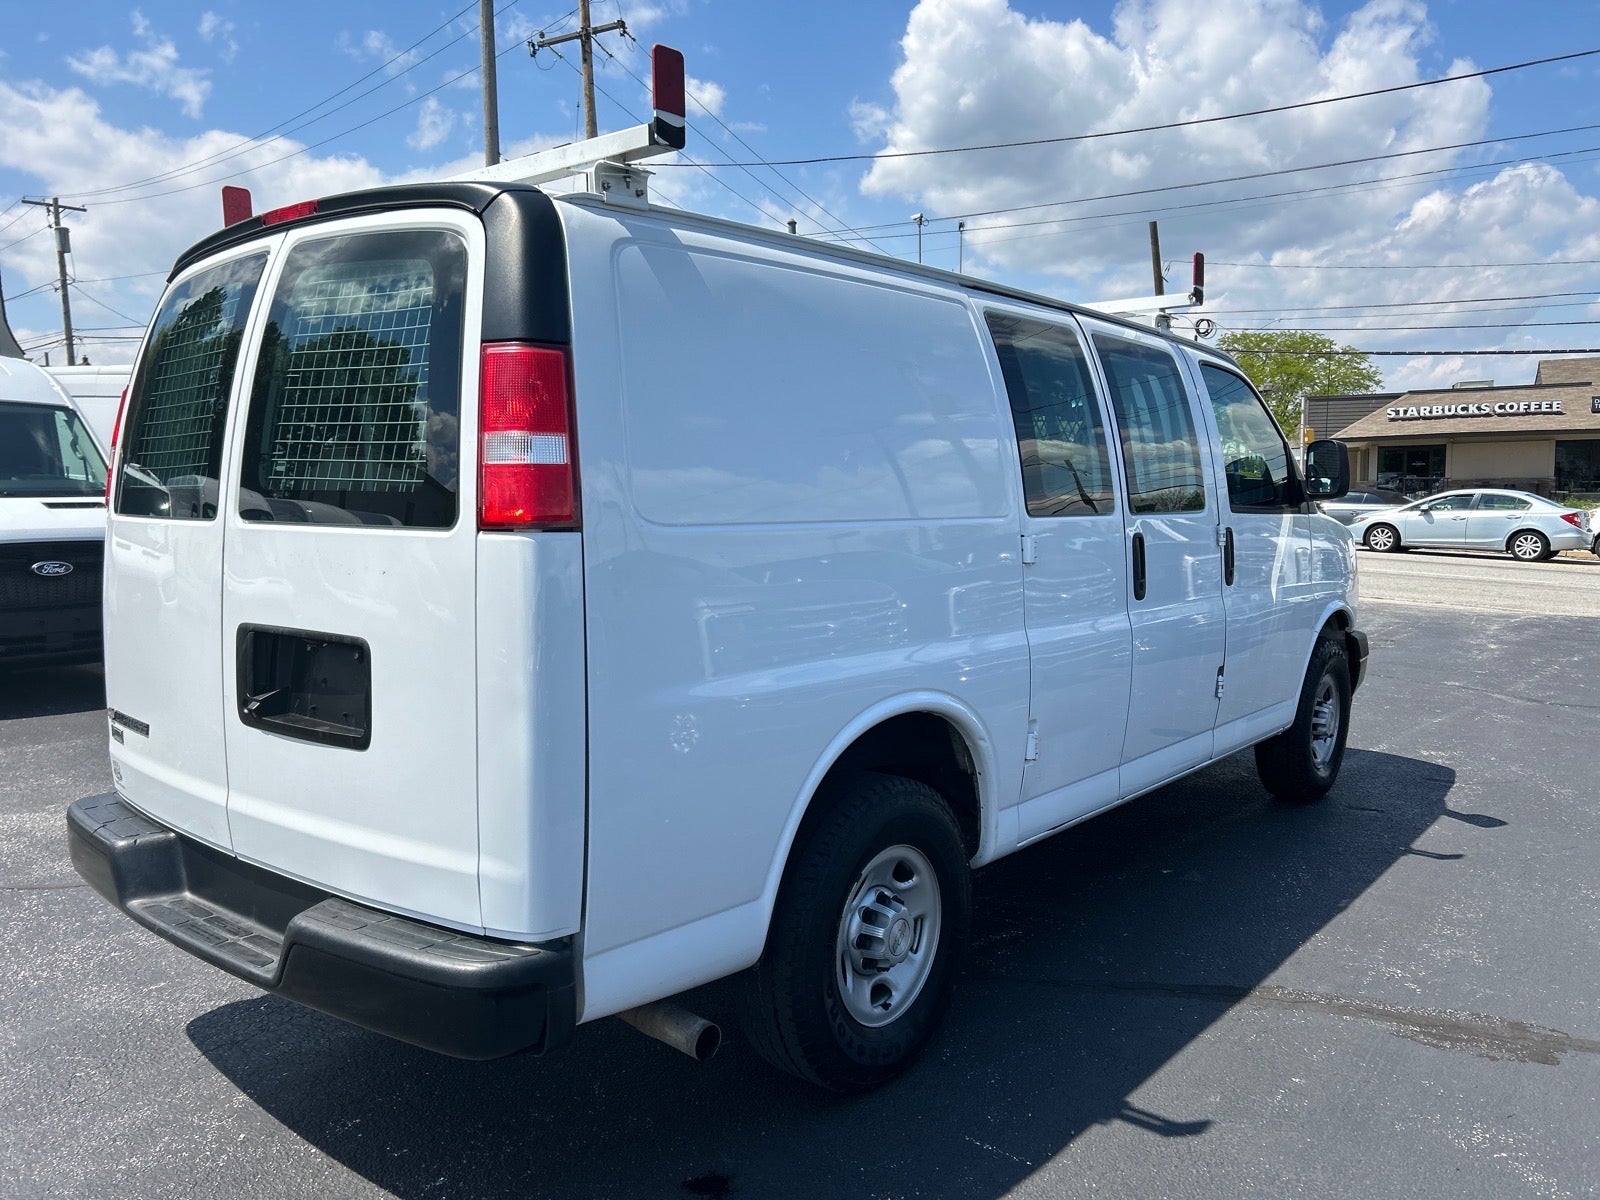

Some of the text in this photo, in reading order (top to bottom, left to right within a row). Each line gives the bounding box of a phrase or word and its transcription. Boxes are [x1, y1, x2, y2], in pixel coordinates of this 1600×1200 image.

[1386, 401, 1562, 418] STARBUCKS COFFEE
[41, 563, 66, 574] Ford
